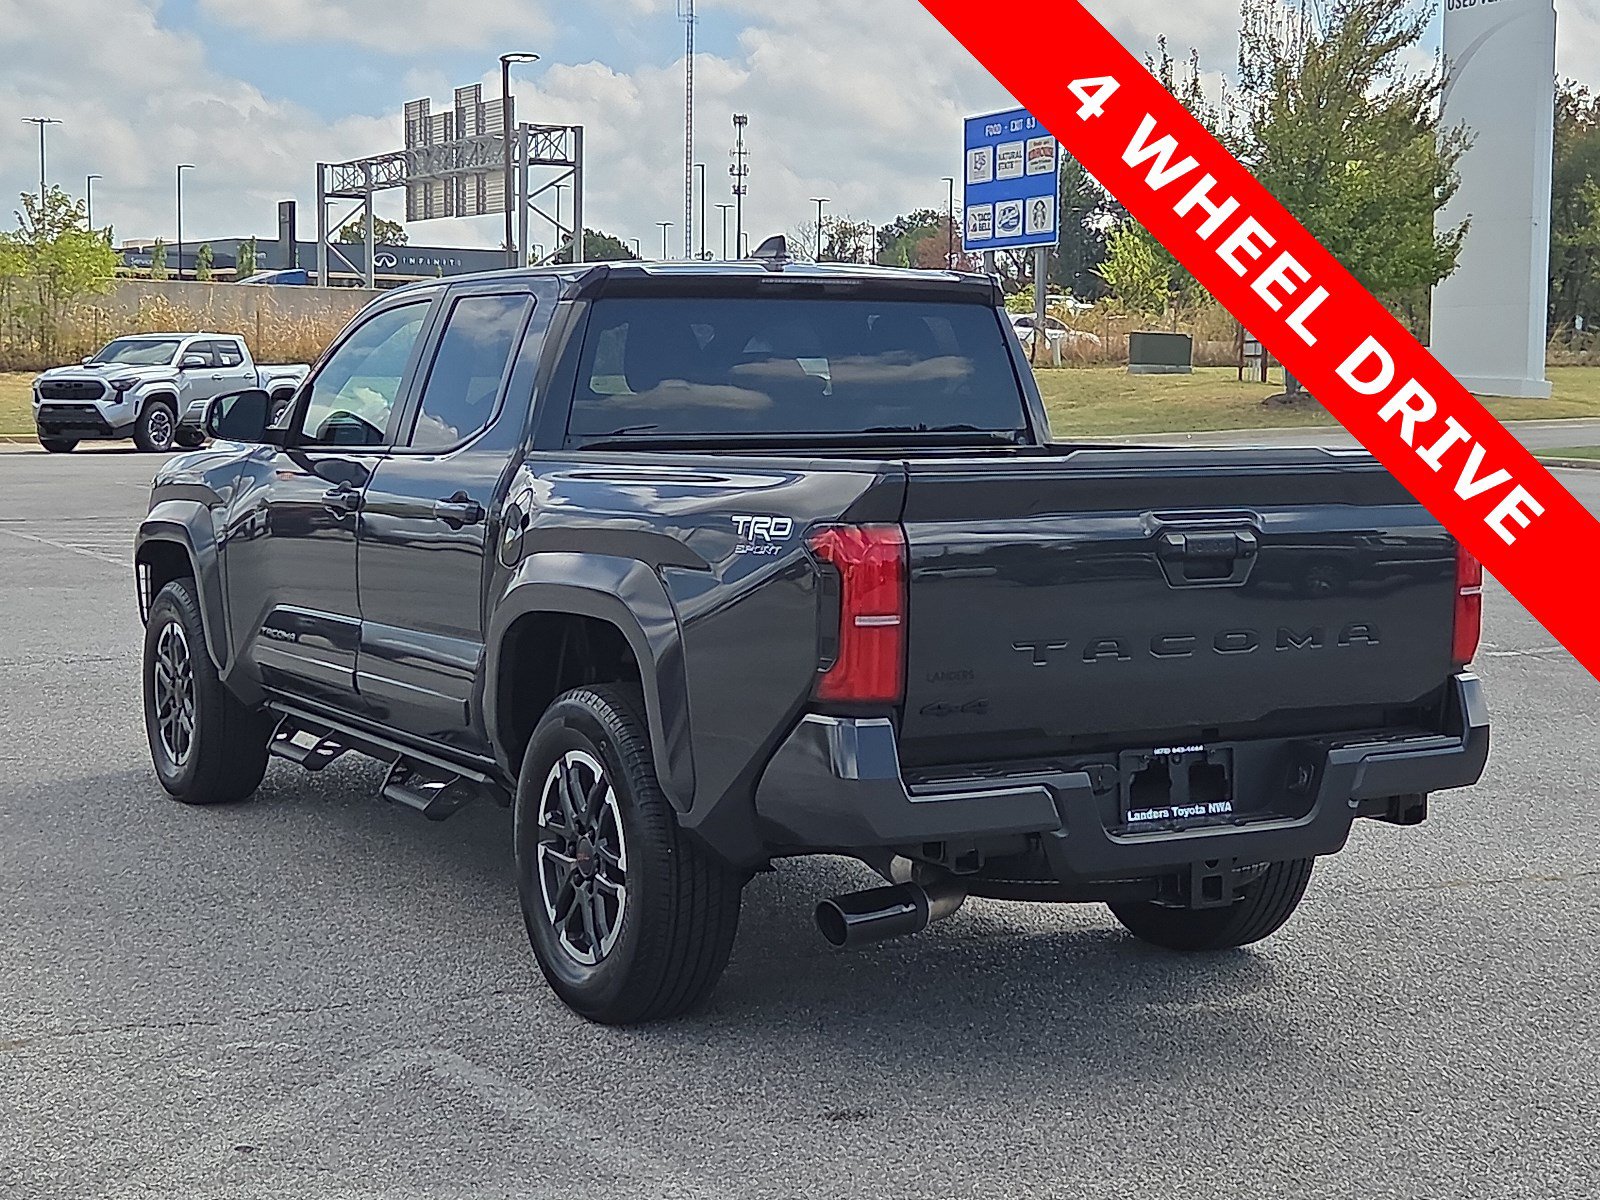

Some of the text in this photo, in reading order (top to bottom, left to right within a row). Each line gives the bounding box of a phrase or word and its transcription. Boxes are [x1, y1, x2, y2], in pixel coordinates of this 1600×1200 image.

[978, 221, 992, 232] BELL
[402, 256, 463, 267] INFINITI
[731, 515, 794, 542] TRD
[734, 544, 783, 556] SPORT
[260, 626, 297, 642] TACOMA
[1010, 620, 1381, 667] TACOMA
[925, 668, 976, 684] LANDERS
[1127, 801, 1233, 822] Landers Toyota NWA
